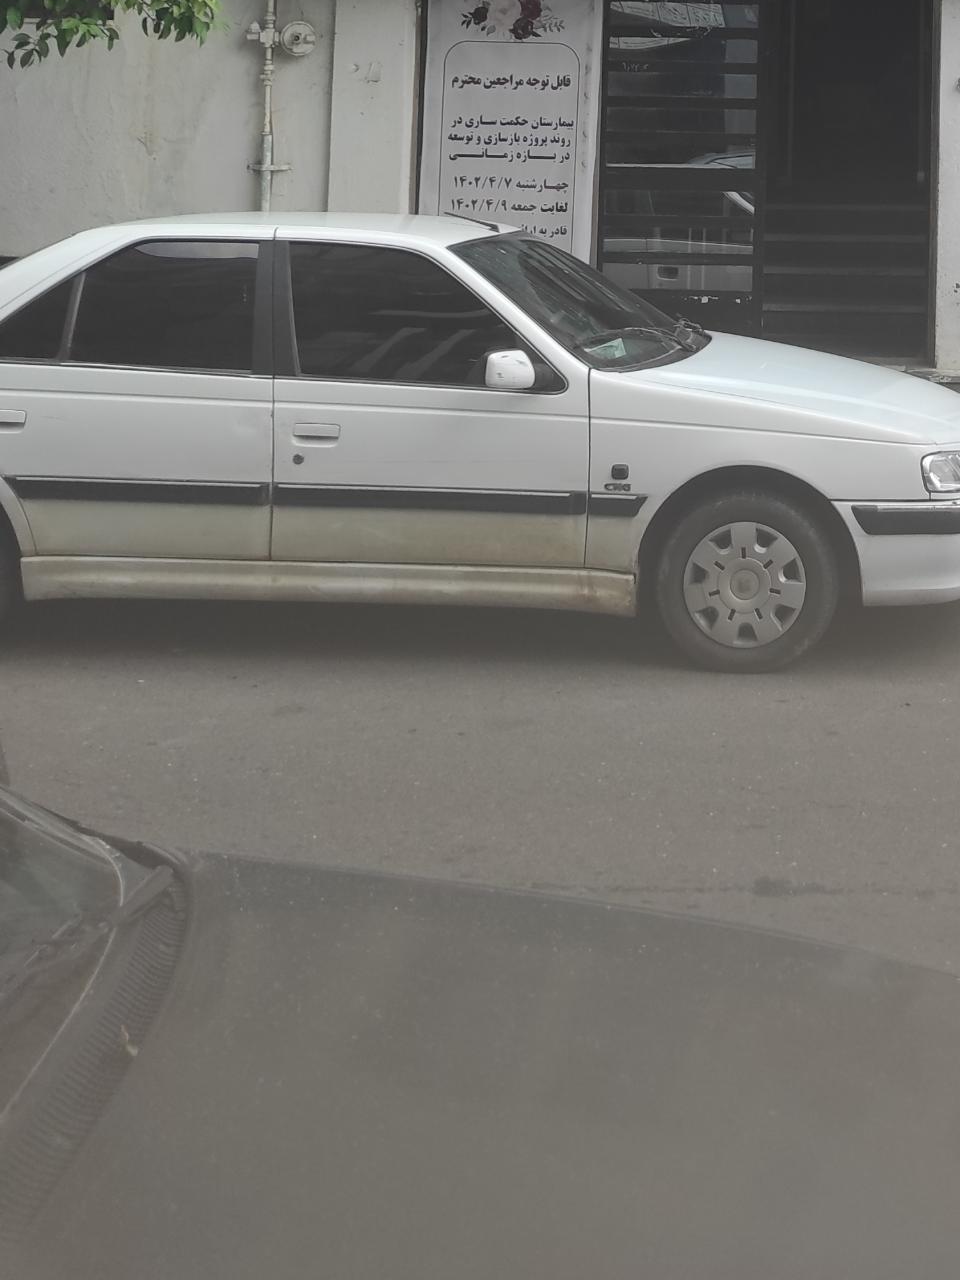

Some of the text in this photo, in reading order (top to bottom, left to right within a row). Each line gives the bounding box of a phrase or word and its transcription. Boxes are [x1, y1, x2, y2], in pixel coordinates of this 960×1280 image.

[451, 73, 571, 91] قابل توجه مراجعین محترم
[451, 114, 574, 130] بیمارستان حکمت ساری در
[447, 131, 474, 145] توسعه
[475, 135, 481, 145] و
[483, 131, 520, 146] بازسازی
[550, 133, 571, 148] روند
[448, 148, 570, 163] در بازه زمانی
[515, 178, 569, 194] چهارشنبه
[510, 203, 537, 215] جمعه
[540, 201, 569, 215] لغایت
[540, 226, 547, 237] به
[550, 225, 568, 239] قادر
